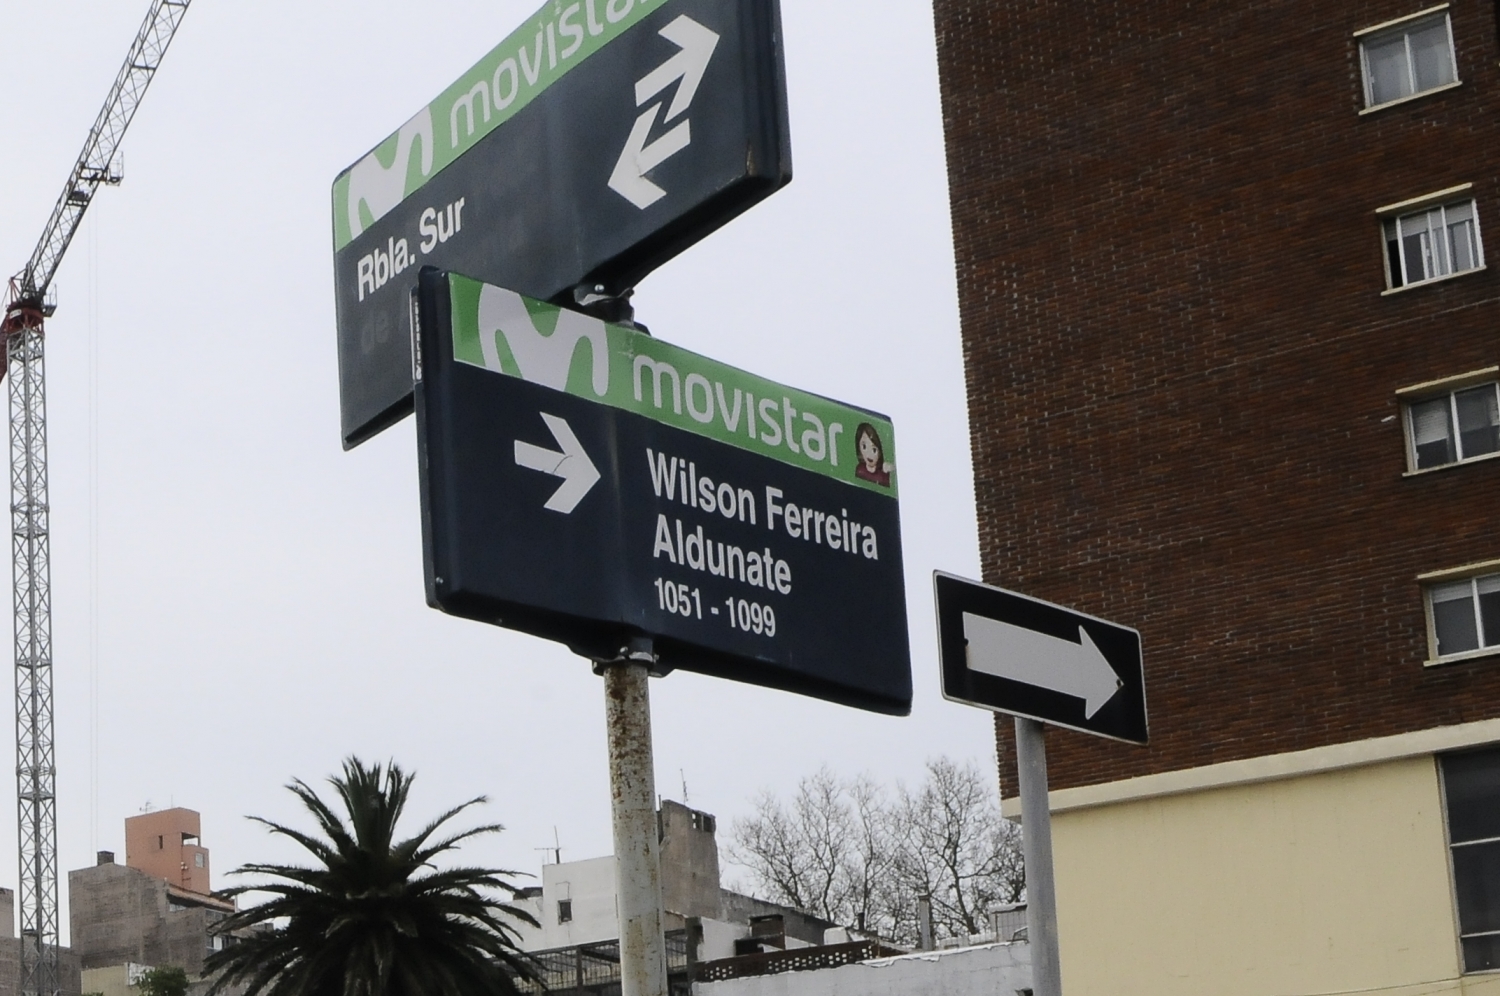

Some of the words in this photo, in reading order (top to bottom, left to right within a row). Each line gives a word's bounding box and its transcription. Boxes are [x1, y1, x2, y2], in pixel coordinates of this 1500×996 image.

[357, 236, 416, 302] Rbla.
[419, 197, 465, 254] Sur
[633, 354, 843, 466] movistar
[646, 448, 757, 525] Wilson
[765, 486, 879, 560] Ferreira
[653, 513, 792, 595] Aldunate
[654, 577, 702, 620] 1051
[725, 596, 776, 638] 1099
